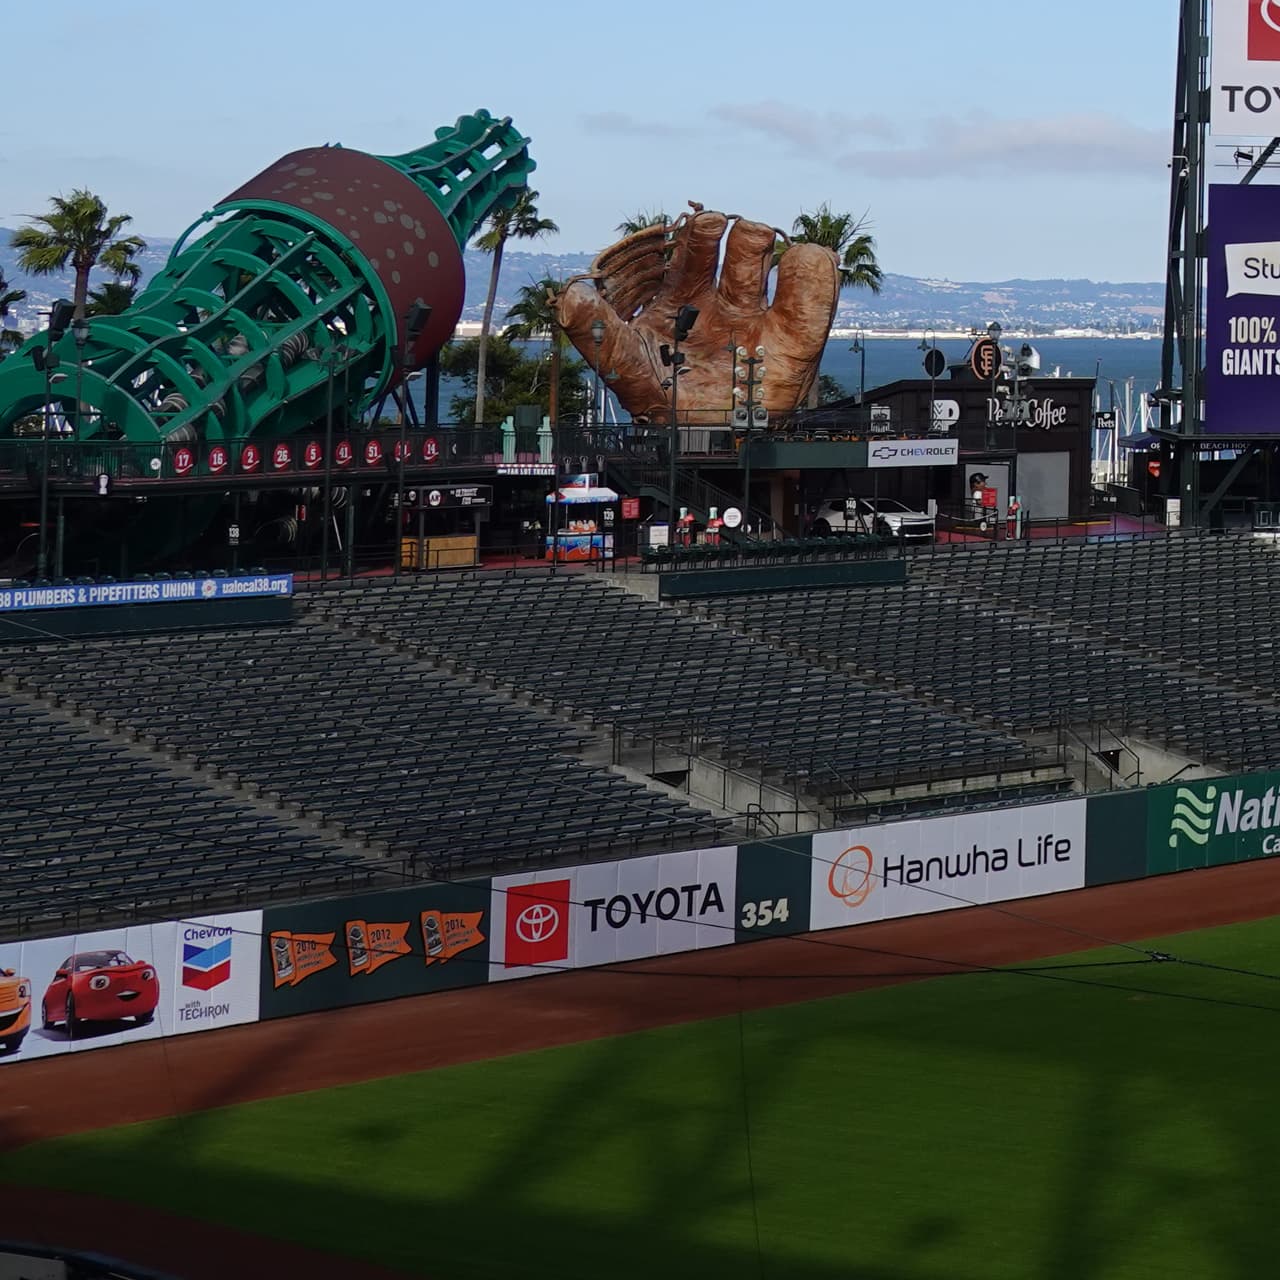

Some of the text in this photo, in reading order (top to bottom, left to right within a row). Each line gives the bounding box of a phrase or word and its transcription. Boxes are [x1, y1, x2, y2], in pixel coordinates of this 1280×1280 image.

[1228, 317, 1276, 343] 100%
[178, 454, 190, 467] 17
[247, 451, 254, 464] 2
[310, 448, 317, 461] 5
[901, 447, 956, 457] CHEVROLET
[14, 586, 75, 607] PLUMBERS
[78, 586, 87, 602] &
[89, 582, 160, 601] PIPEFITTERS
[162, 581, 195, 598] UNION
[222, 577, 288, 595] ualocal38.org
[883, 833, 1072, 889] Hanwha Life
[584, 881, 725, 933] TOYOTA
[741, 898, 790, 930] 354
[183, 926, 233, 942] Chevron
[444, 918, 466, 935] 2014
[370, 928, 392, 944] 2012
[296, 939, 318, 956] 2010
[179, 1003, 230, 1022] TECHRON
[185, 1000, 201, 1010] with
